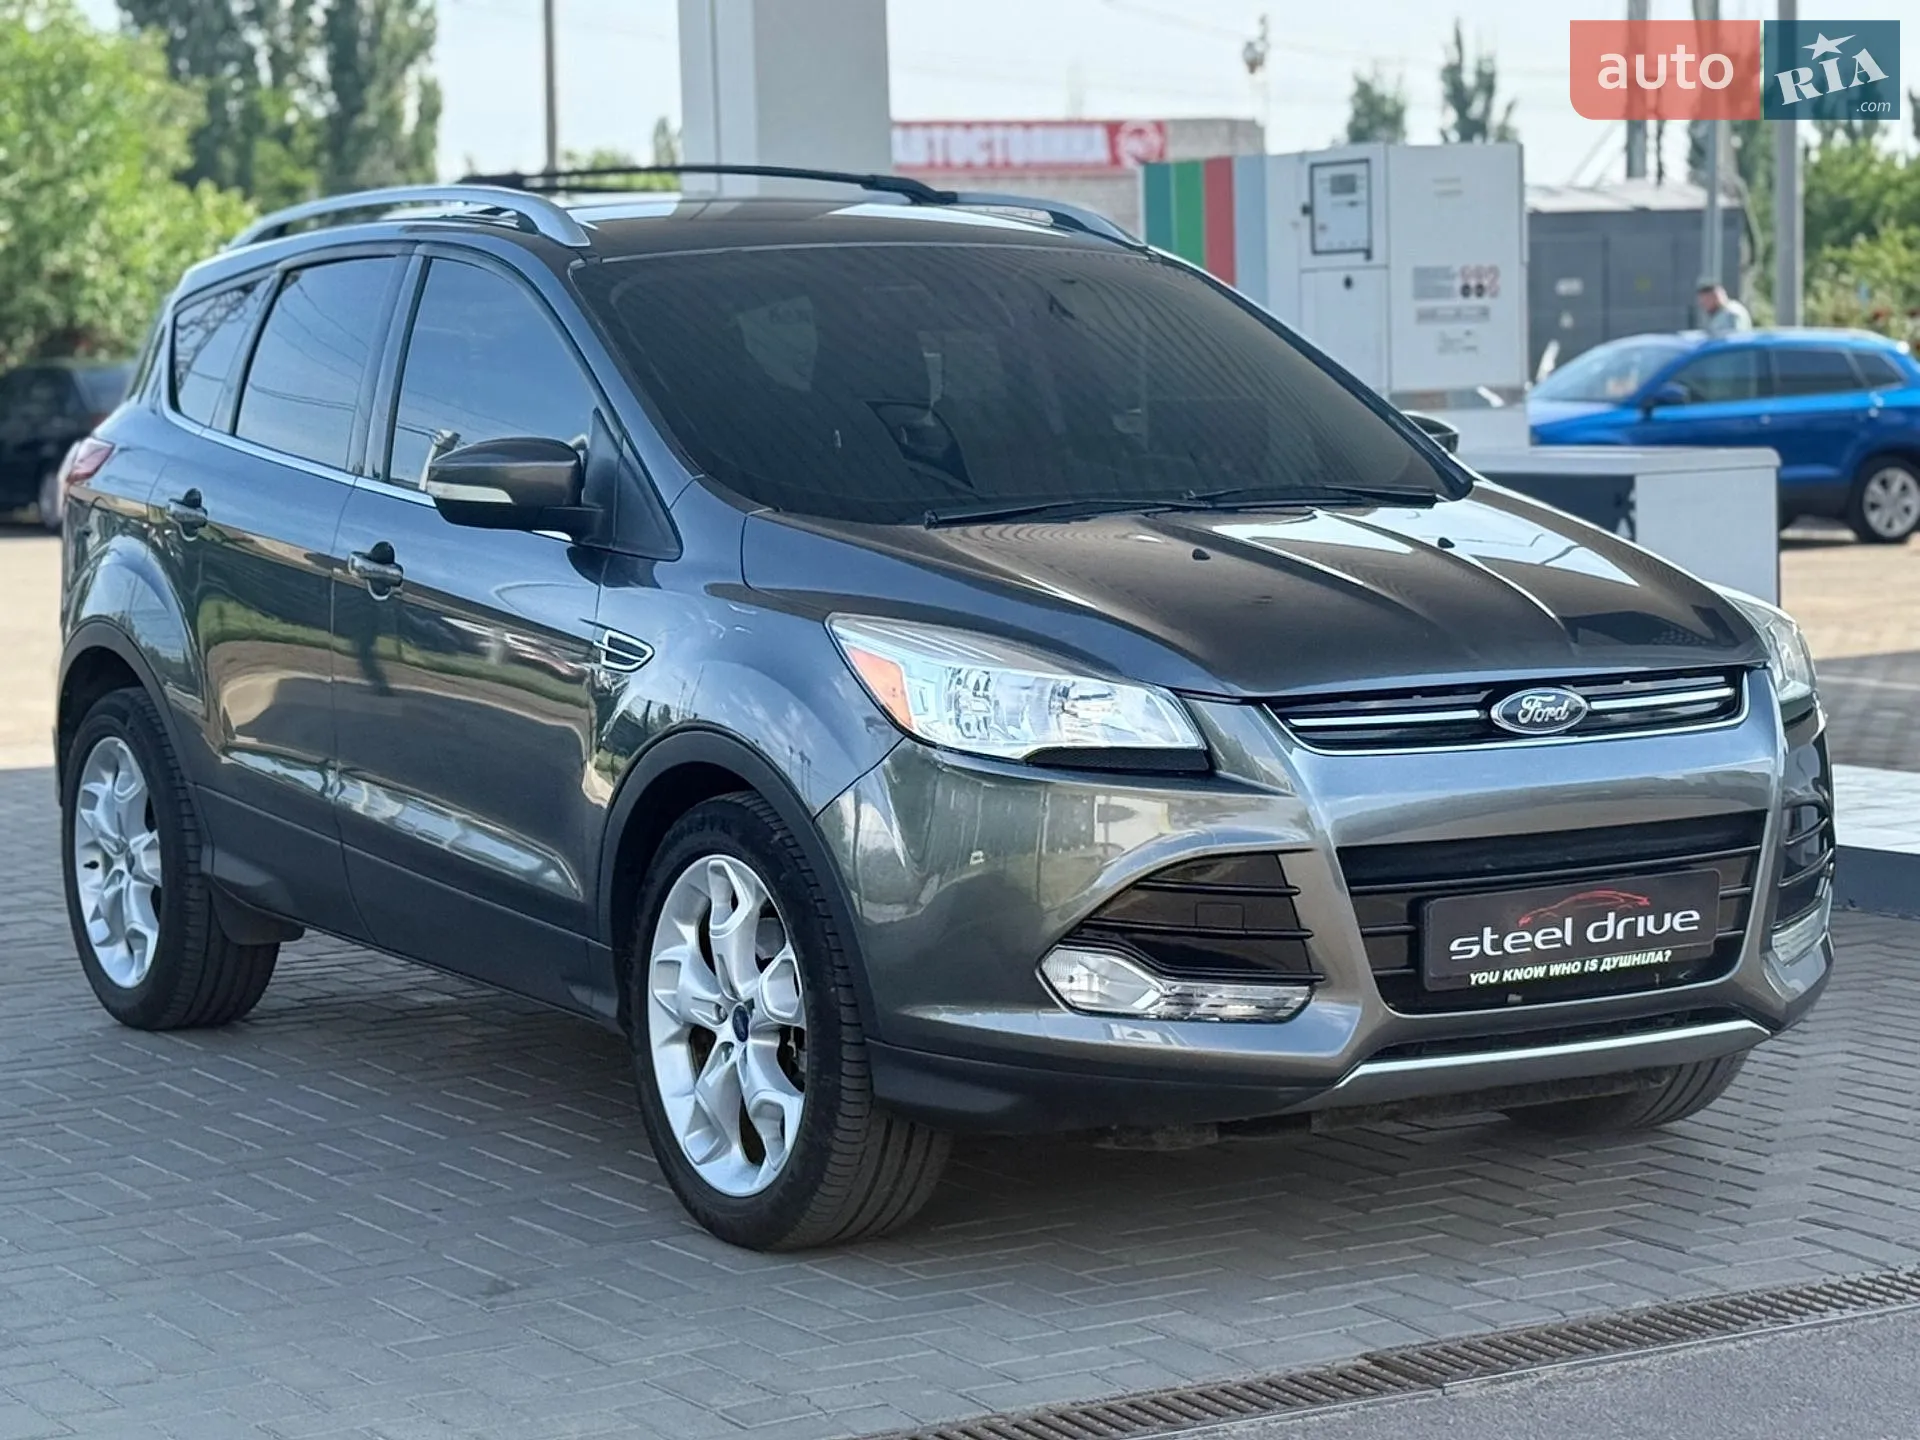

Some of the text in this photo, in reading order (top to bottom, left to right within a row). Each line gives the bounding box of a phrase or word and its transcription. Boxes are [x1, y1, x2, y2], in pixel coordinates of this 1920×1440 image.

[1517, 694, 1570, 724] Ford
[1450, 909, 1700, 960] steel drive
[1469, 971, 1499, 985] YOU
[1502, 965, 1547, 982] KNOW
[1549, 961, 1583, 977] WHO
[1584, 958, 1599, 972] IS
